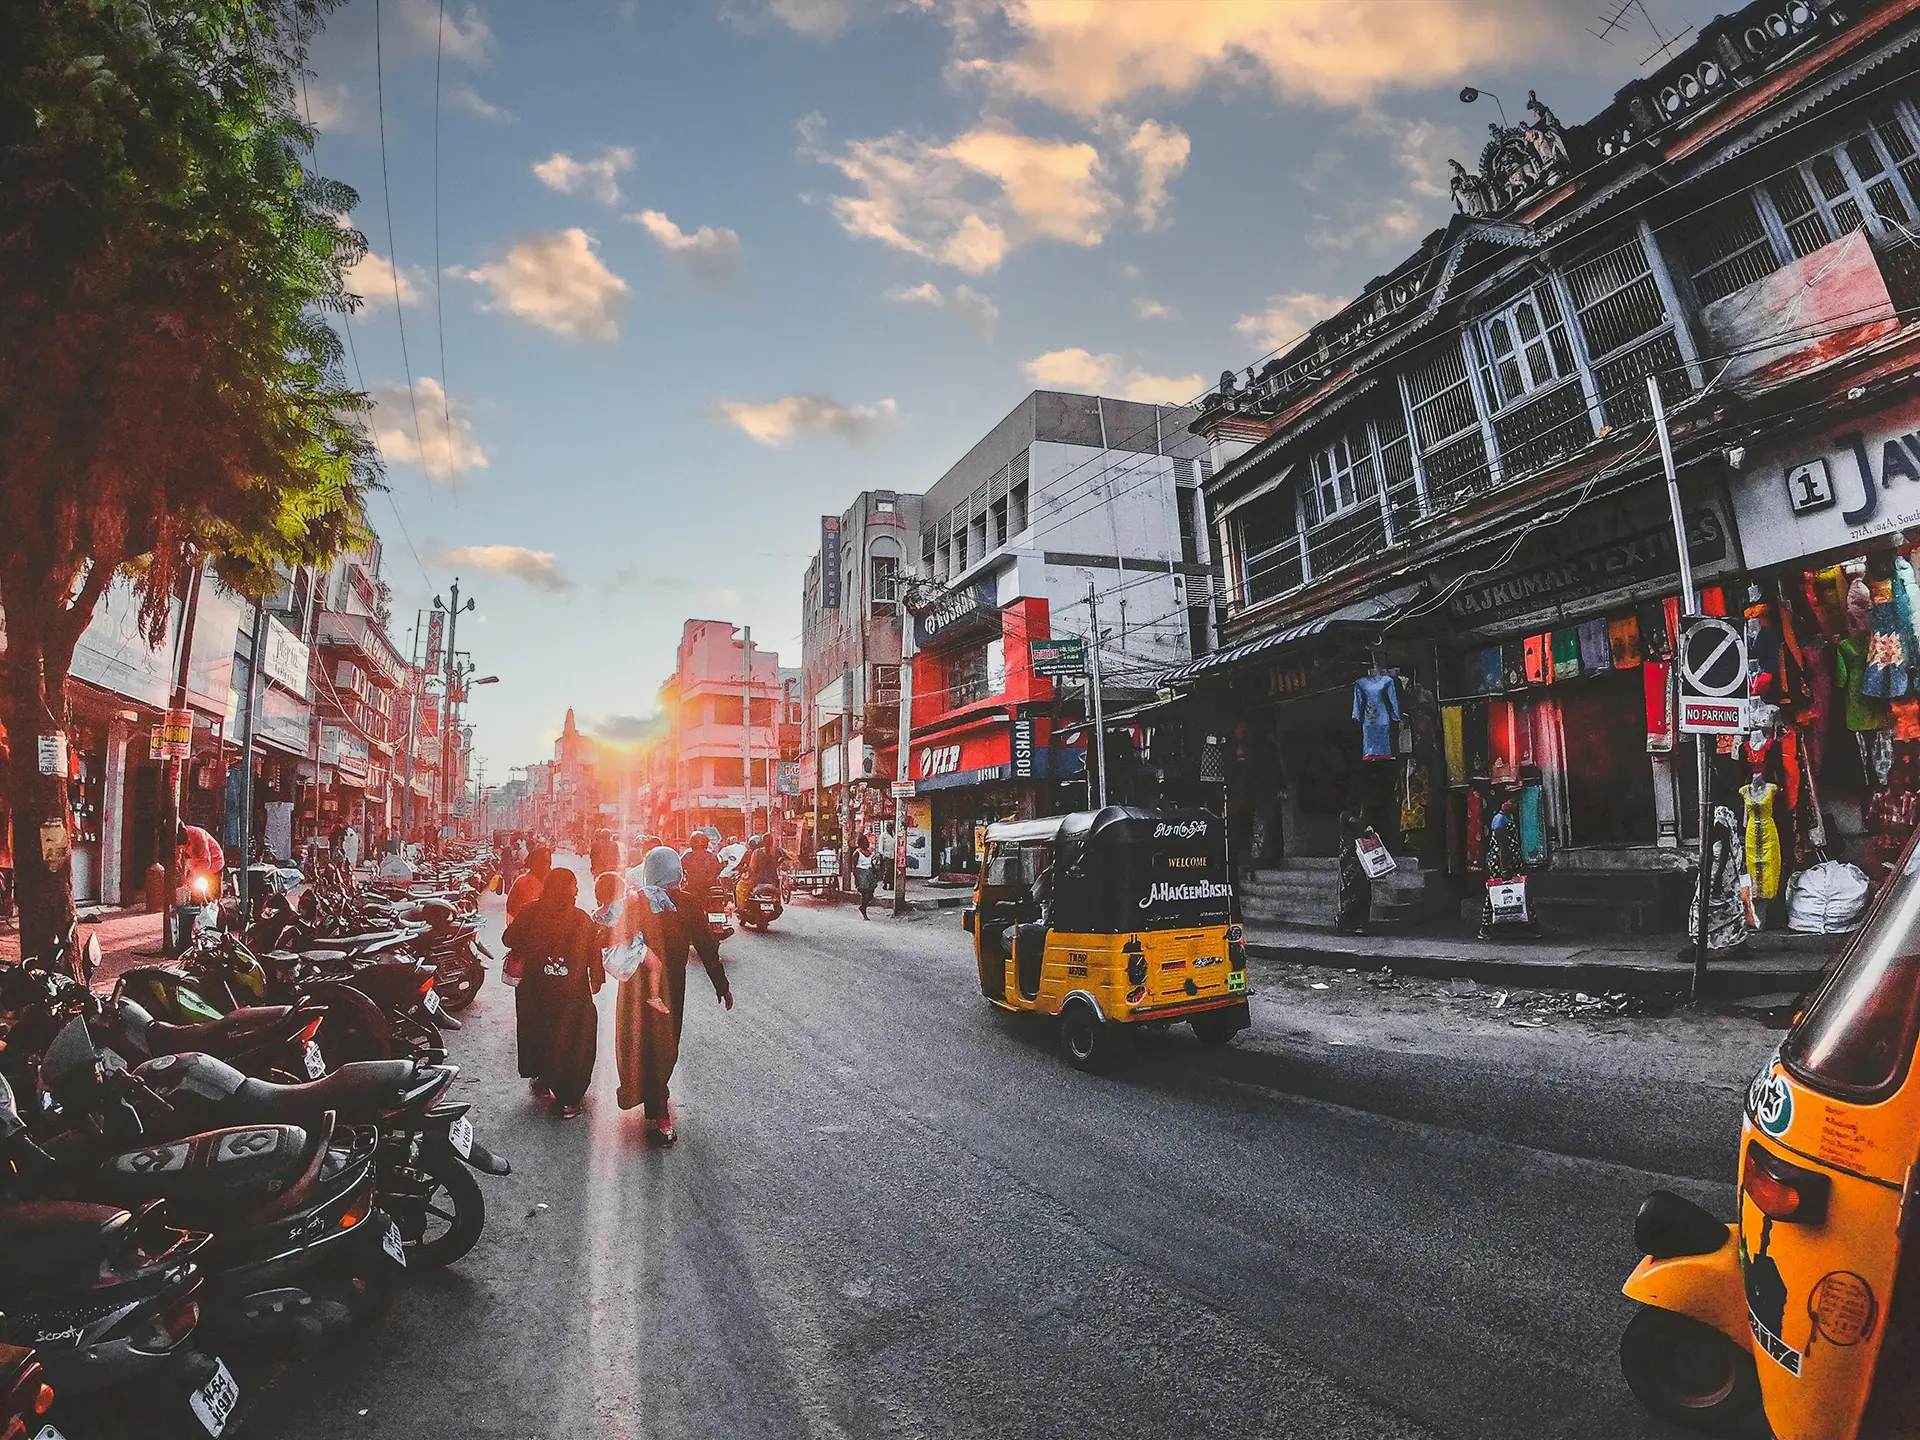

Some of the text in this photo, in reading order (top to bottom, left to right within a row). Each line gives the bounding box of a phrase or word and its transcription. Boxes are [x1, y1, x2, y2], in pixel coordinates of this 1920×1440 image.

[1687, 709, 1738, 722] NO PARKING
[1015, 720, 1031, 777] ROSHAN
[1168, 857, 1207, 867] WELCOME
[35, 1325, 84, 1347] Scooty
